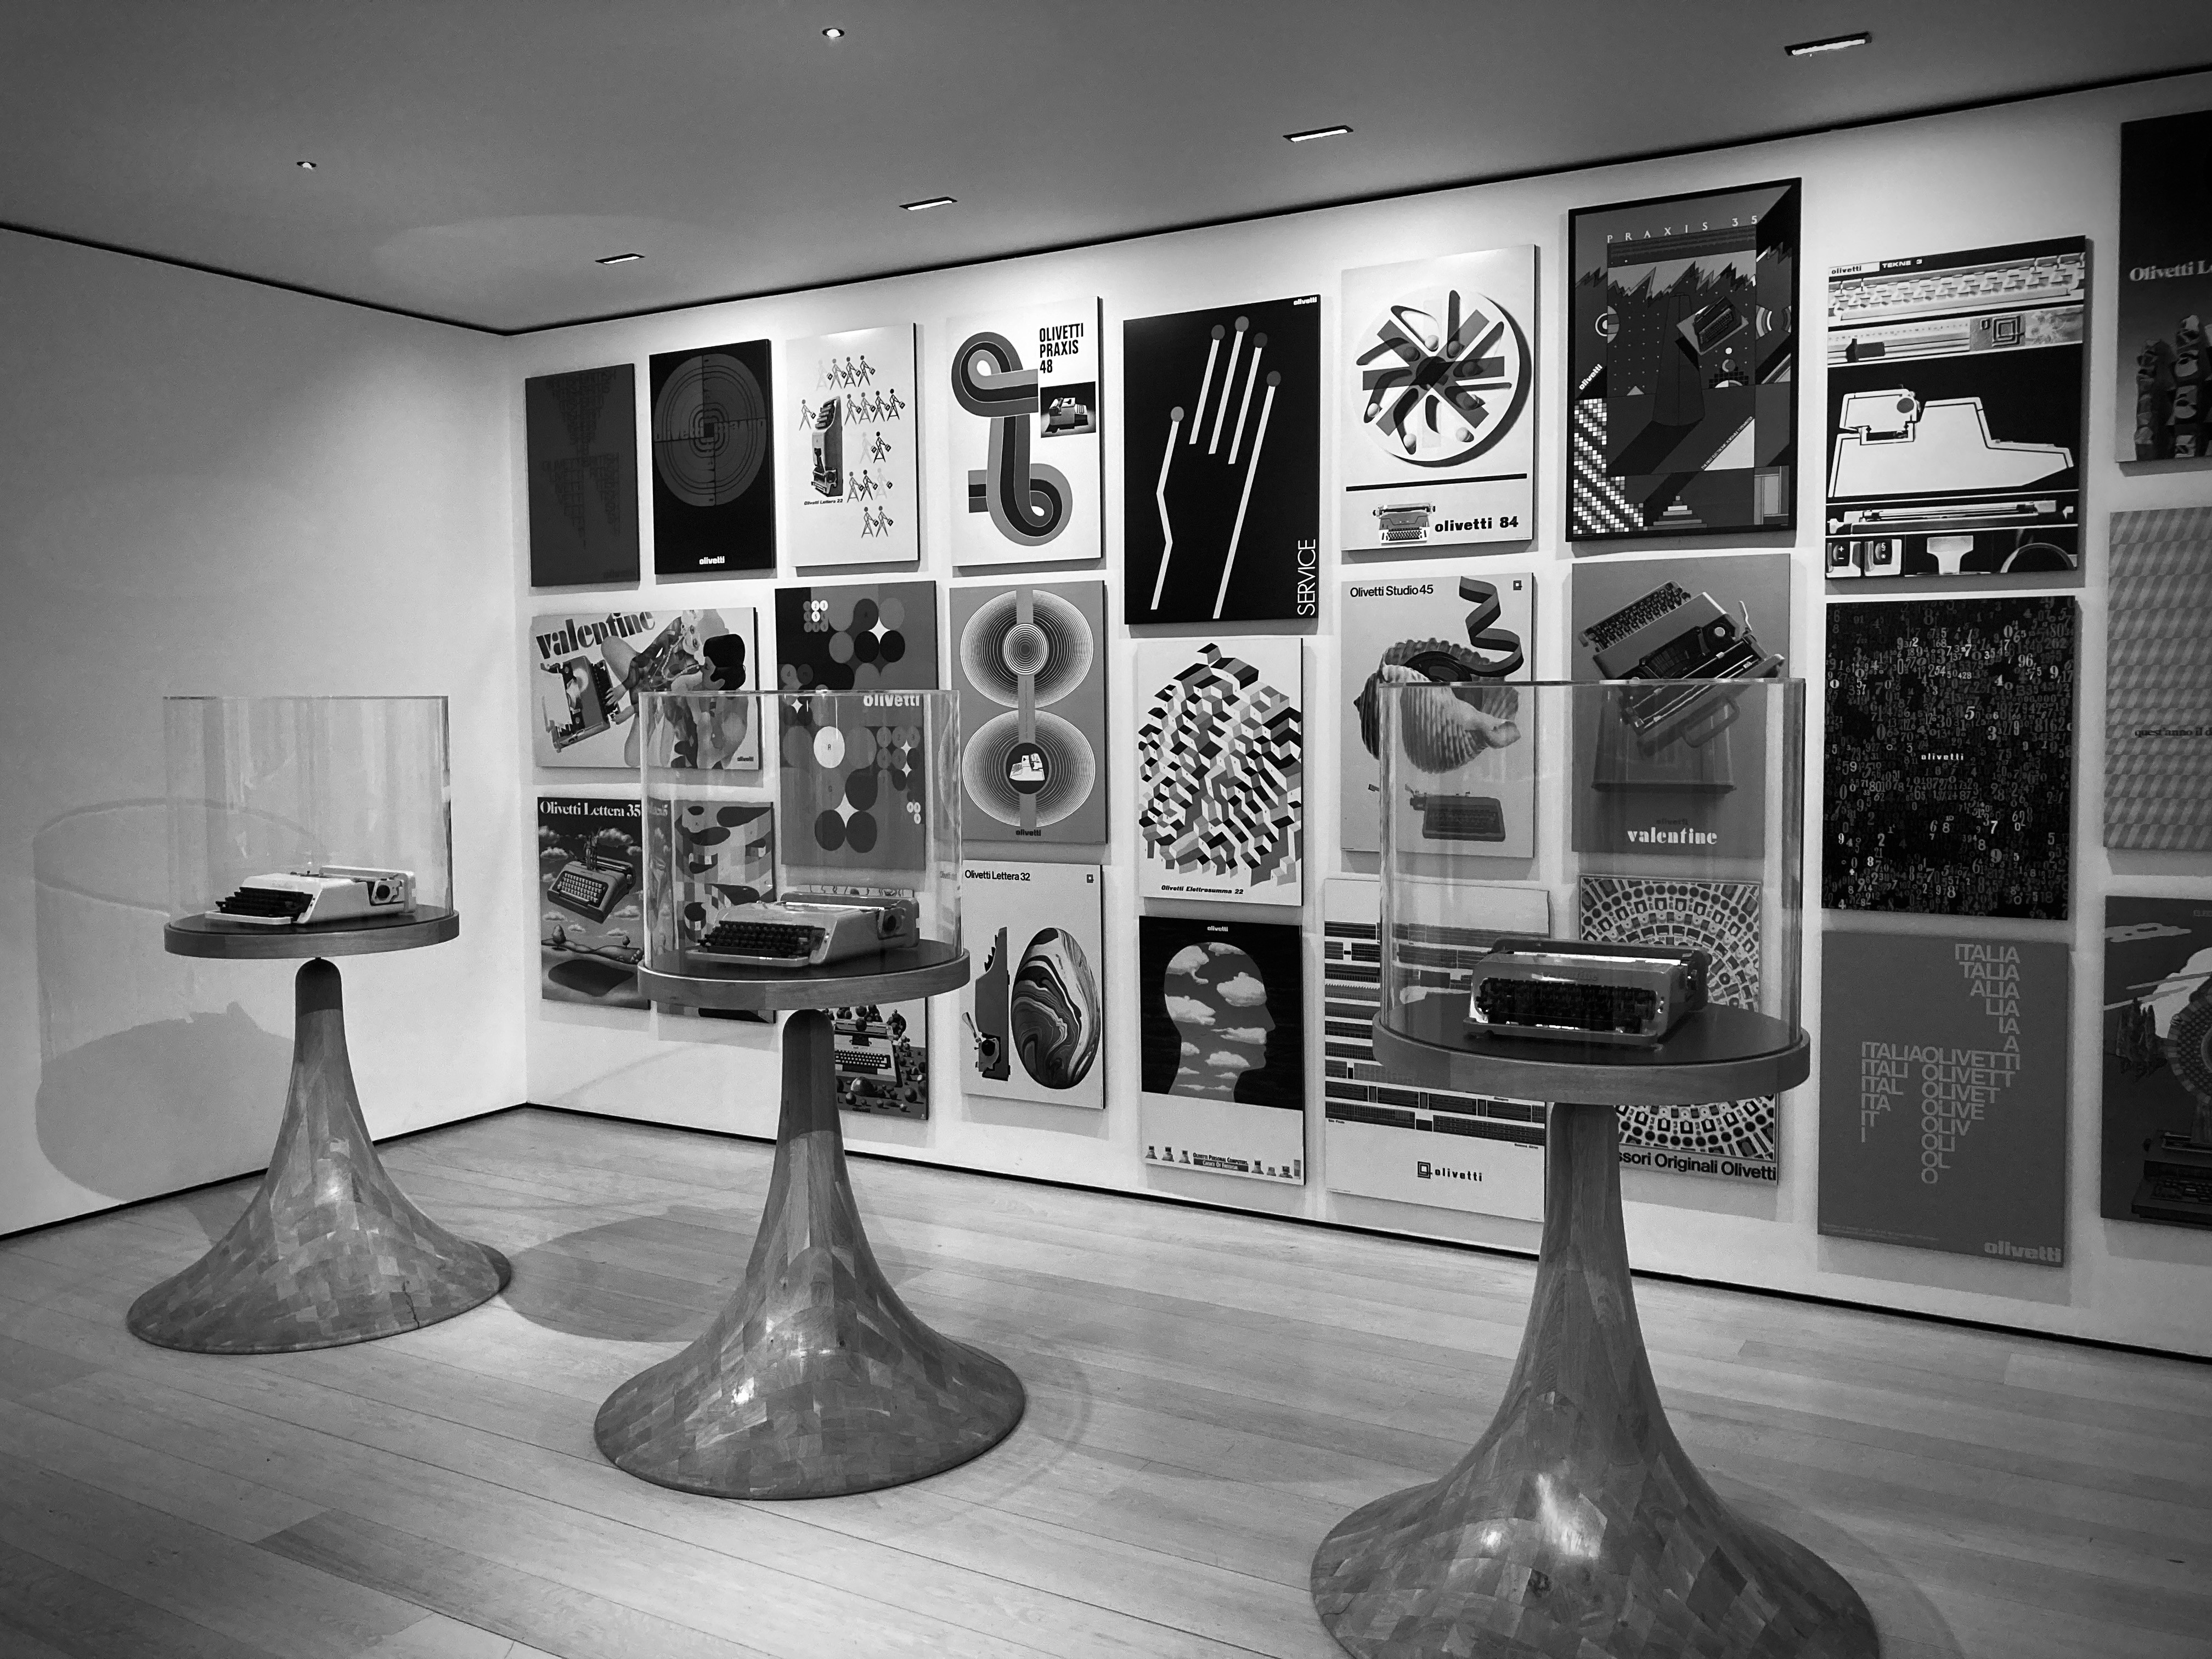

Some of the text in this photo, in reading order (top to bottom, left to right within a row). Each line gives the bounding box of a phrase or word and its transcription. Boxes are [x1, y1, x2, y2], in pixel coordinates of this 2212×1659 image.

[1607, 222, 1708, 244] PRAXIS
[1732, 215, 1757, 227] 35
[1831, 266, 1862, 274] olivetti
[1882, 260, 1911, 268] TEKNE
[2130, 261, 2194, 281] Olivetti
[1293, 296, 1317, 306] olivetti
[1039, 323, 1084, 342] OLIVETTI
[1040, 339, 1079, 358] PRAXIS
[1039, 359, 1053, 374] 48
[1579, 364, 1602, 390] olivetti
[1435, 516, 1519, 532] olivetti 84
[699, 556, 725, 565] olivetti
[1297, 539, 1316, 616] SERVICE
[1350, 584, 1434, 597] Olivetti Studio 45
[535, 611, 656, 659] valentine
[864, 695, 920, 707] olivetti
[2135, 727, 2193, 738] quest'anno
[540, 800, 582, 815] Olivetti
[583, 802, 625, 817] Lettera
[626, 804, 641, 817] 35
[1627, 827, 1718, 845] valentine
[964, 870, 991, 879] Olivetti
[992, 871, 1019, 881] Lettera
[1020, 872, 1031, 881] 32
[1955, 944, 2021, 963] ITALIA
[1959, 961, 2020, 981] TALIA
[1970, 979, 2020, 999] ALIA
[1985, 998, 2020, 1017] LIA
[1999, 1017, 2021, 1035] IA
[2004, 1035, 2019, 1052] A
[1861, 1058, 2016, 1088] ITALI OLIVETT
[1861, 1075, 2000, 1103] ITAL OLIVET
[1861, 1092, 1985, 1120] ITA OLIVE
[1861, 1110, 1972, 1136] IT OLIV
[1921, 1133, 1956, 1152] OLI
[1654, 1153, 1718, 1173] Originali
[1721, 1160, 1776, 1181] Olivetti
[1921, 1150, 1952, 1169] OL
[1435, 1167, 1482, 1182] olivetti
[1921, 1167, 1938, 1184] O
[1984, 1240, 2062, 1262] olivetti
